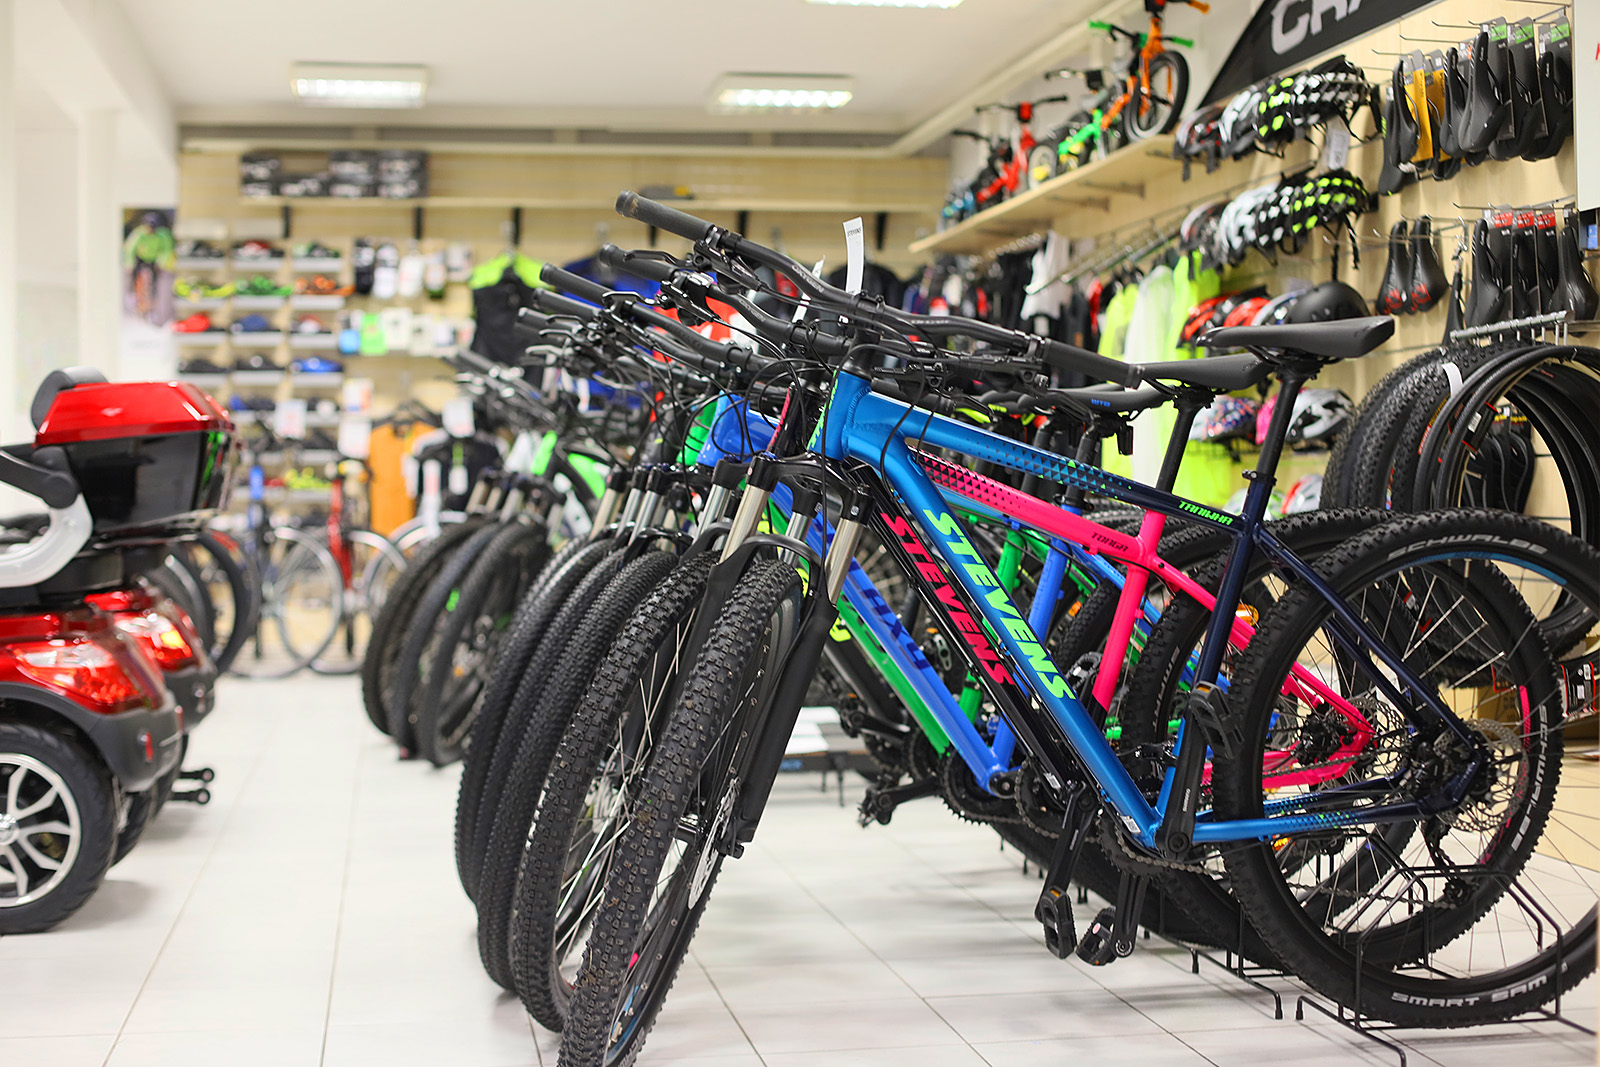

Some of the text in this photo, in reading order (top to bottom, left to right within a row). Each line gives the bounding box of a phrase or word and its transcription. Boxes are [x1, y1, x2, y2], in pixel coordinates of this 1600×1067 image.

[1271, 0, 1361, 55] CR
[1178, 500, 1234, 526] TANIWHA
[1091, 532, 1129, 552] TONGA
[1387, 533, 1548, 561] SCHWALBE
[880, 512, 1016, 685] STEVENS
[923, 509, 1077, 700] STEVENS
[1510, 704, 1549, 852] SCHWALBE
[1391, 974, 1548, 1007] SMART SAM
